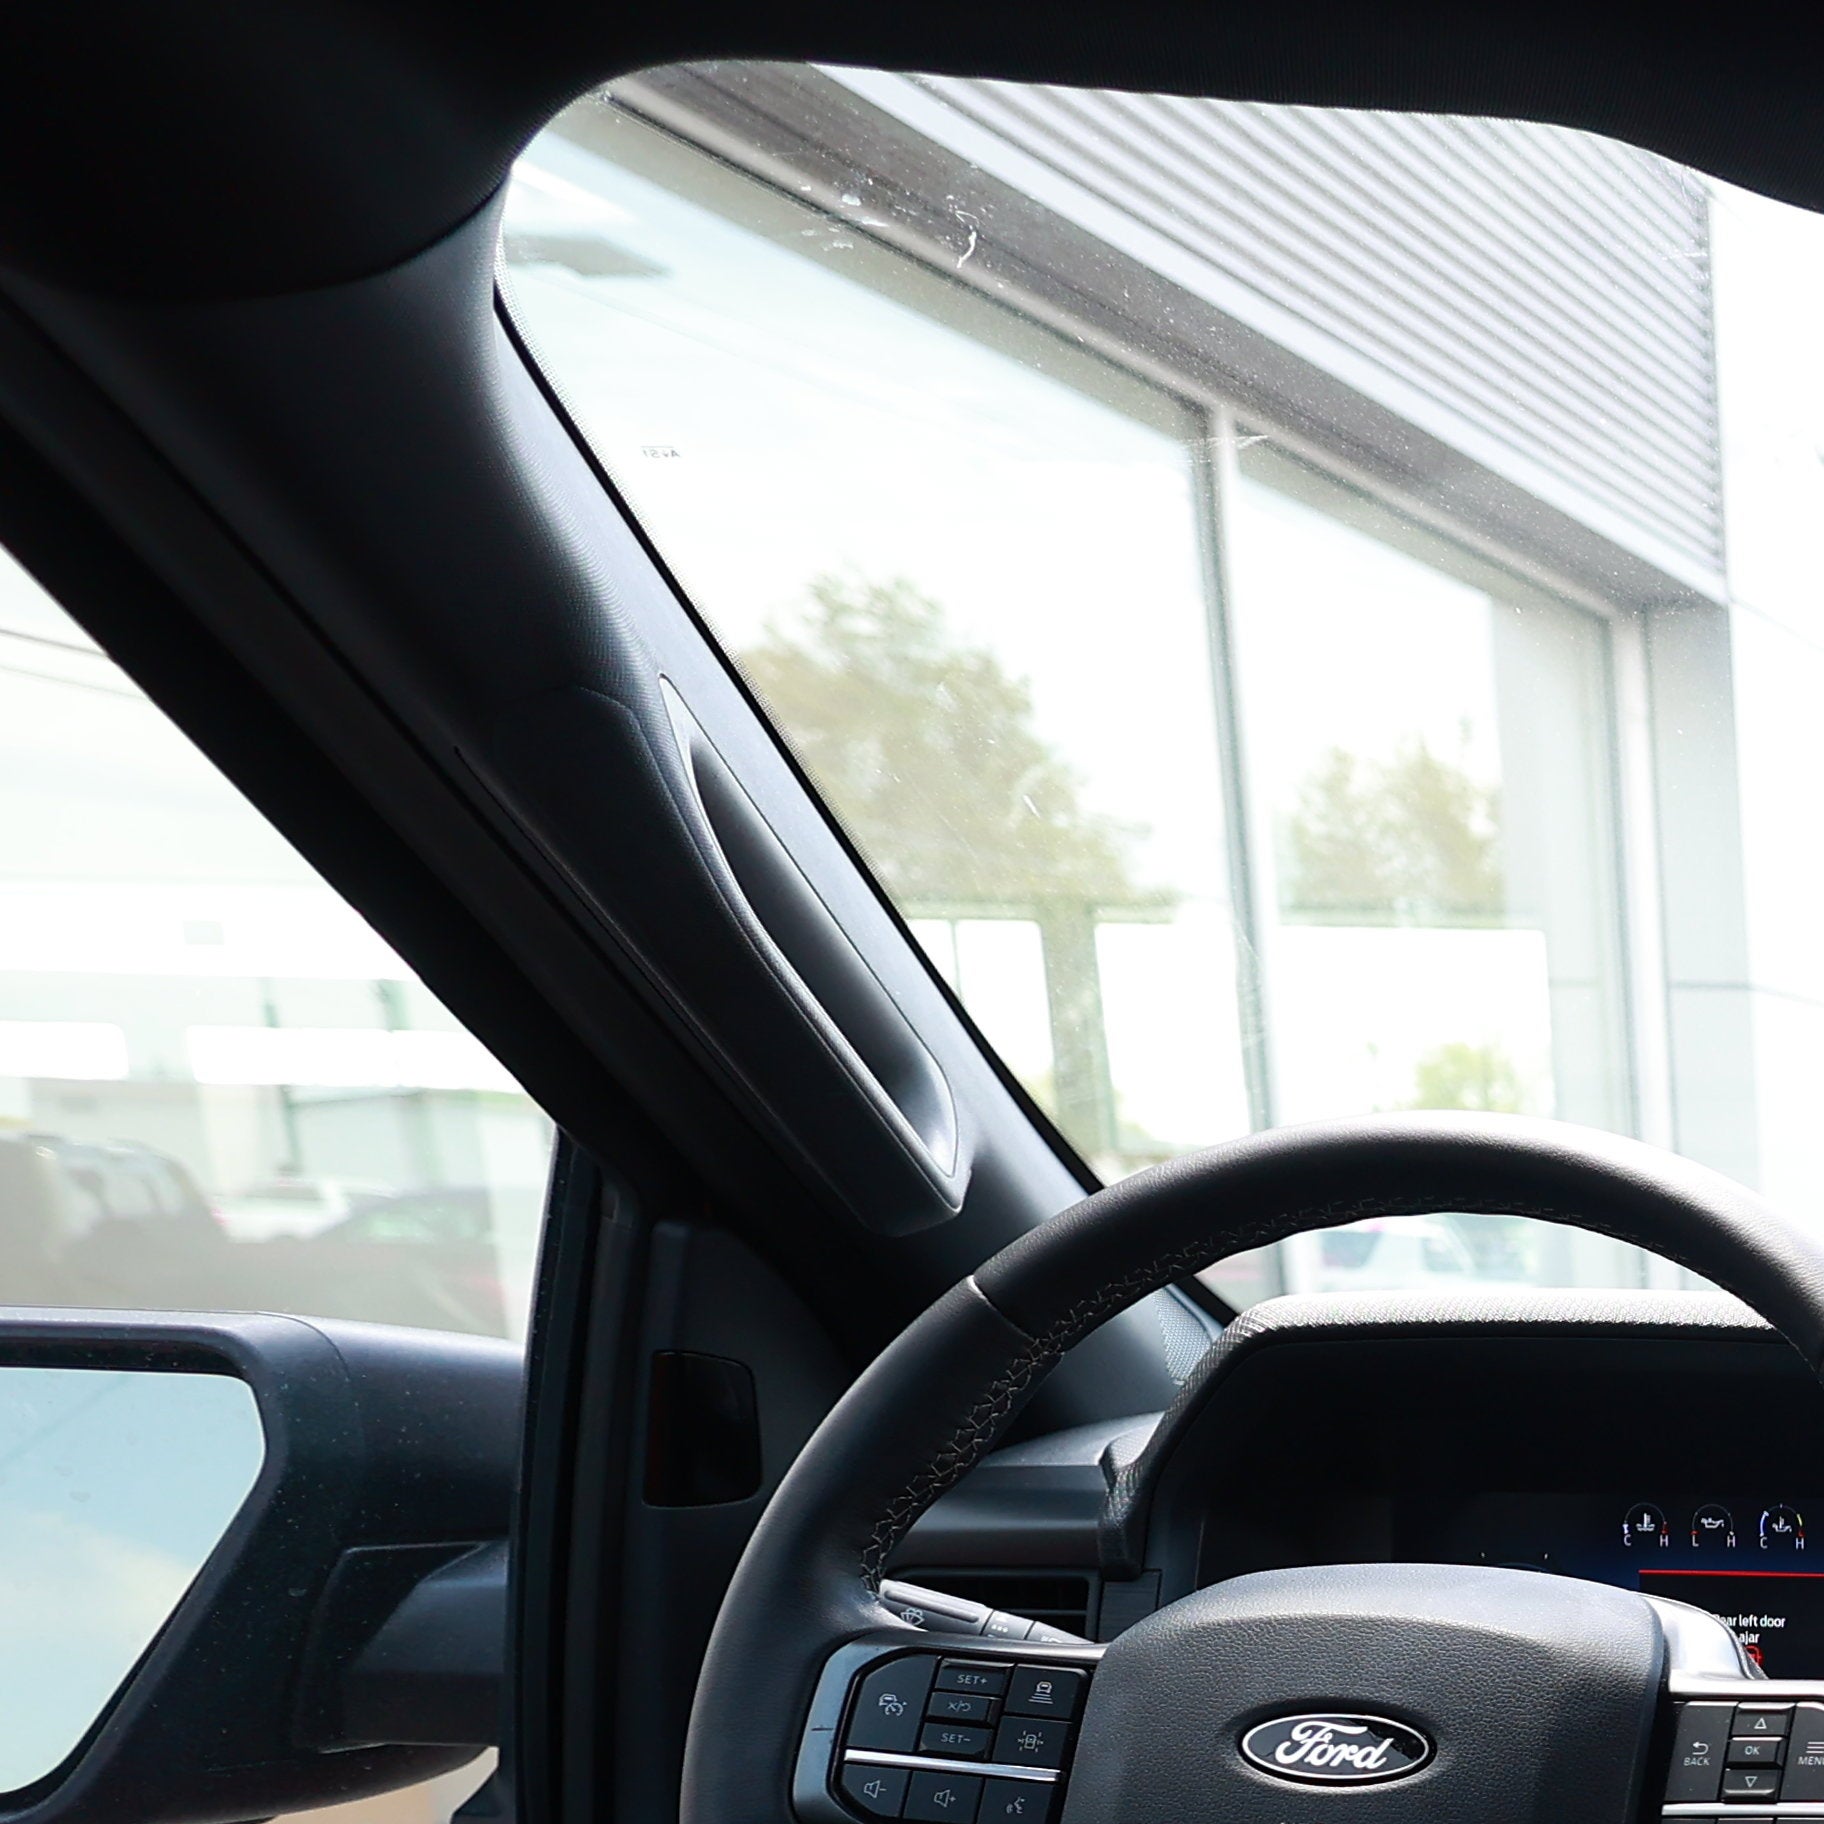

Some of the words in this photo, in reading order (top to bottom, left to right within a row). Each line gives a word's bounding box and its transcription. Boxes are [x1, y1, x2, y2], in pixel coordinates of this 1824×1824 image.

[1659, 1535, 1669, 1547] H
[1692, 1534, 1699, 1547] L
[1727, 1535, 1736, 1547] H
[1795, 1537, 1805, 1550] H
[1738, 1613, 1758, 1627] left
[1759, 1614, 1786, 1628] door
[1739, 1630, 1760, 1645] ajar
[1275, 1721, 1394, 1770] Ford
[1744, 1745, 1760, 1756] OK
[1683, 1756, 1710, 1766] BACK
